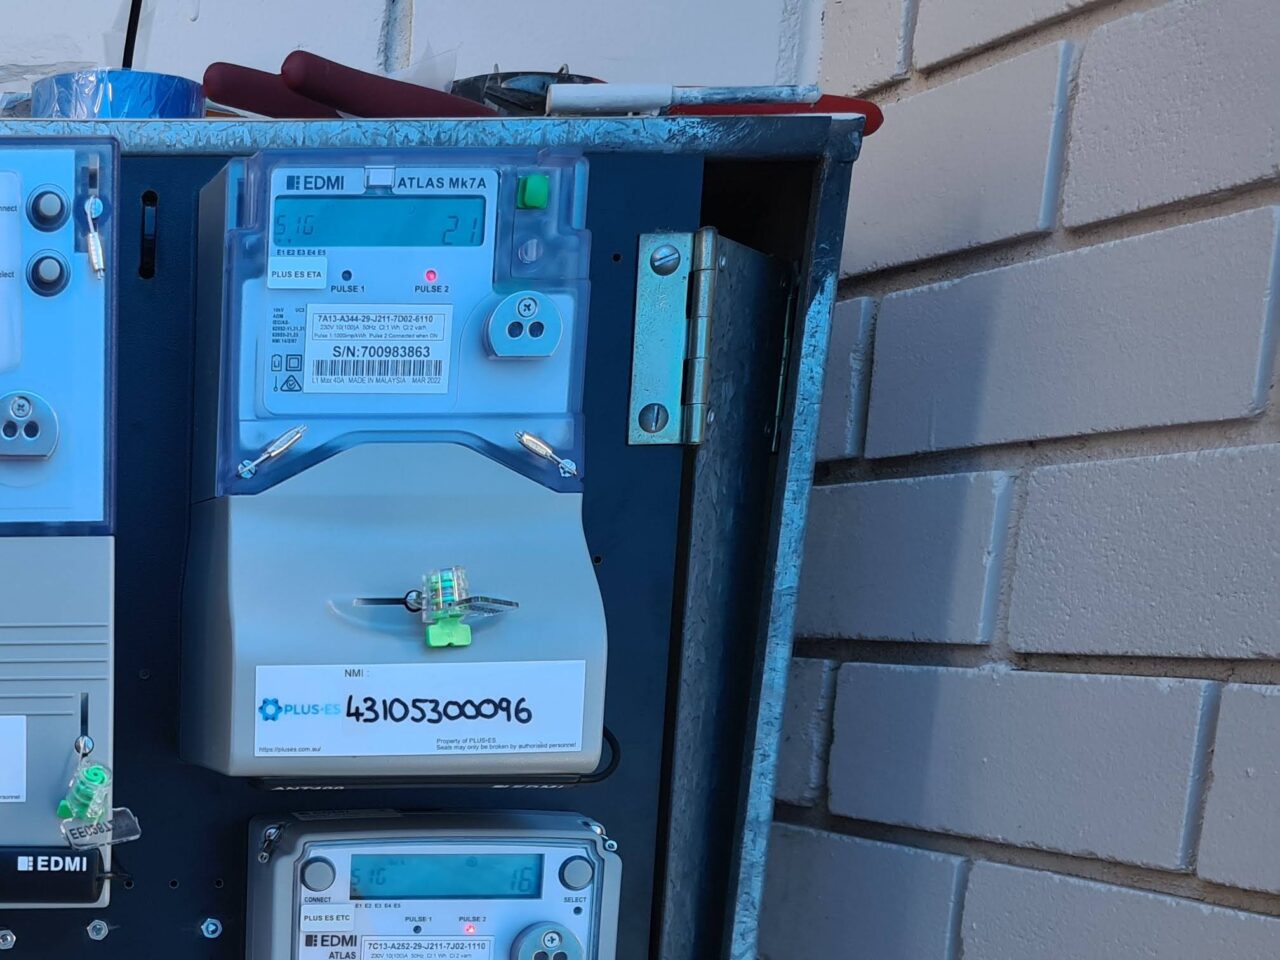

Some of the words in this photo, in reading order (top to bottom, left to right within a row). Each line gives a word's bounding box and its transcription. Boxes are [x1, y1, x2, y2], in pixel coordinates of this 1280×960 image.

[304, 175, 344, 190] EDMI
[398, 177, 445, 189] ATLAS
[449, 177, 487, 189] Mk7A
[331, 285, 359, 293] PULSE
[361, 285, 365, 293] 1
[415, 285, 442, 293] PULSE
[444, 285, 449, 293] 2
[333, 346, 430, 358] S/N:700983863
[344, 669, 364, 678] NMI
[346, 694, 532, 724] 43105300096
[37, 856, 87, 871] EDMI
[321, 935, 357, 947] EDMI
[329, 951, 356, 960] ATLAS
